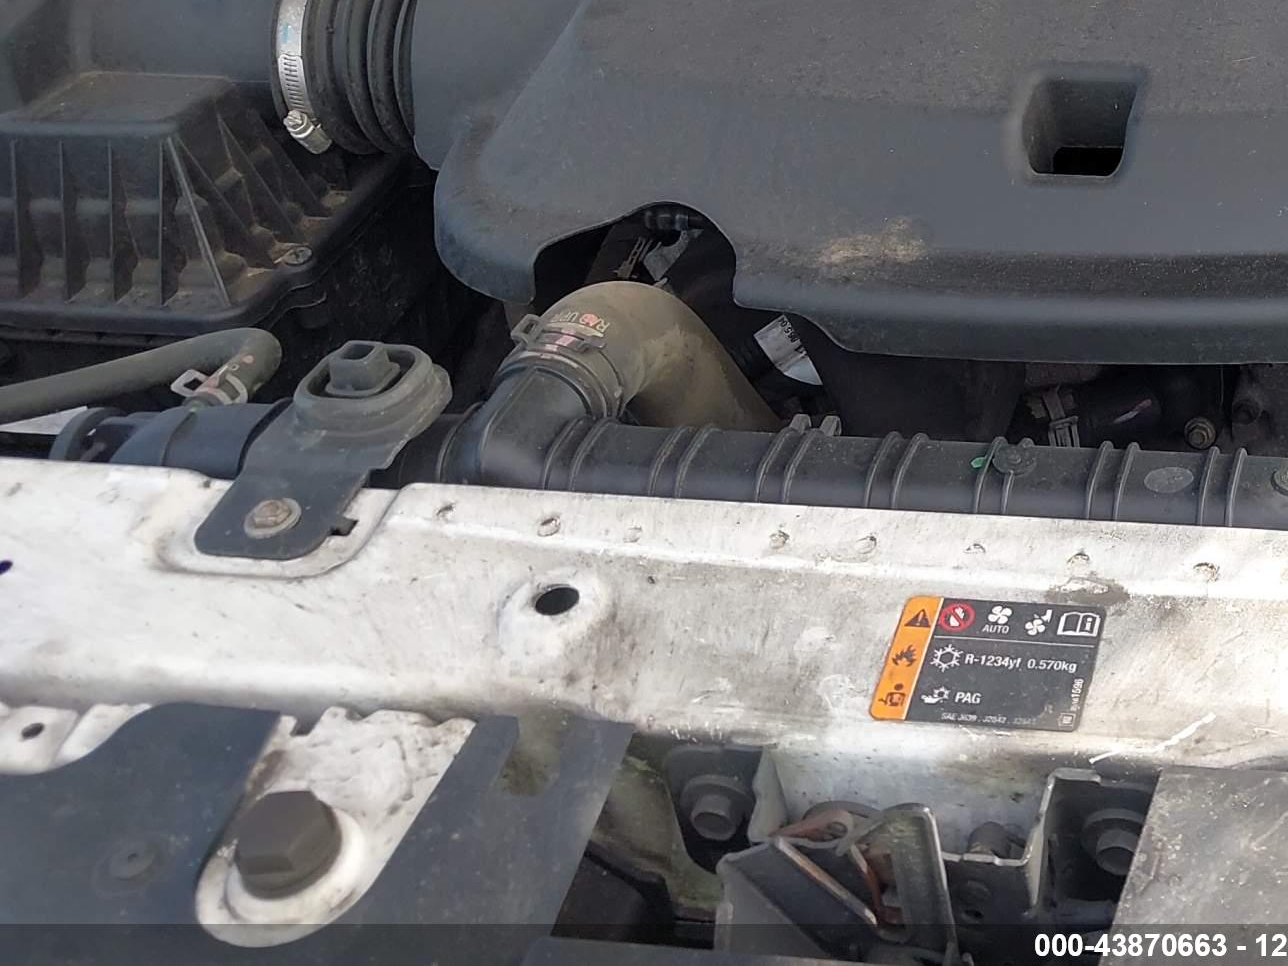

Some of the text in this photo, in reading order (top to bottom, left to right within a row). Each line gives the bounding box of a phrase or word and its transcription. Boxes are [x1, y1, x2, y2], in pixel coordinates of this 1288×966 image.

[982, 624, 1010, 634] AUTO
[964, 655, 1078, 674] R-1234yf 0.570kg
[954, 692, 982, 704] PAG
